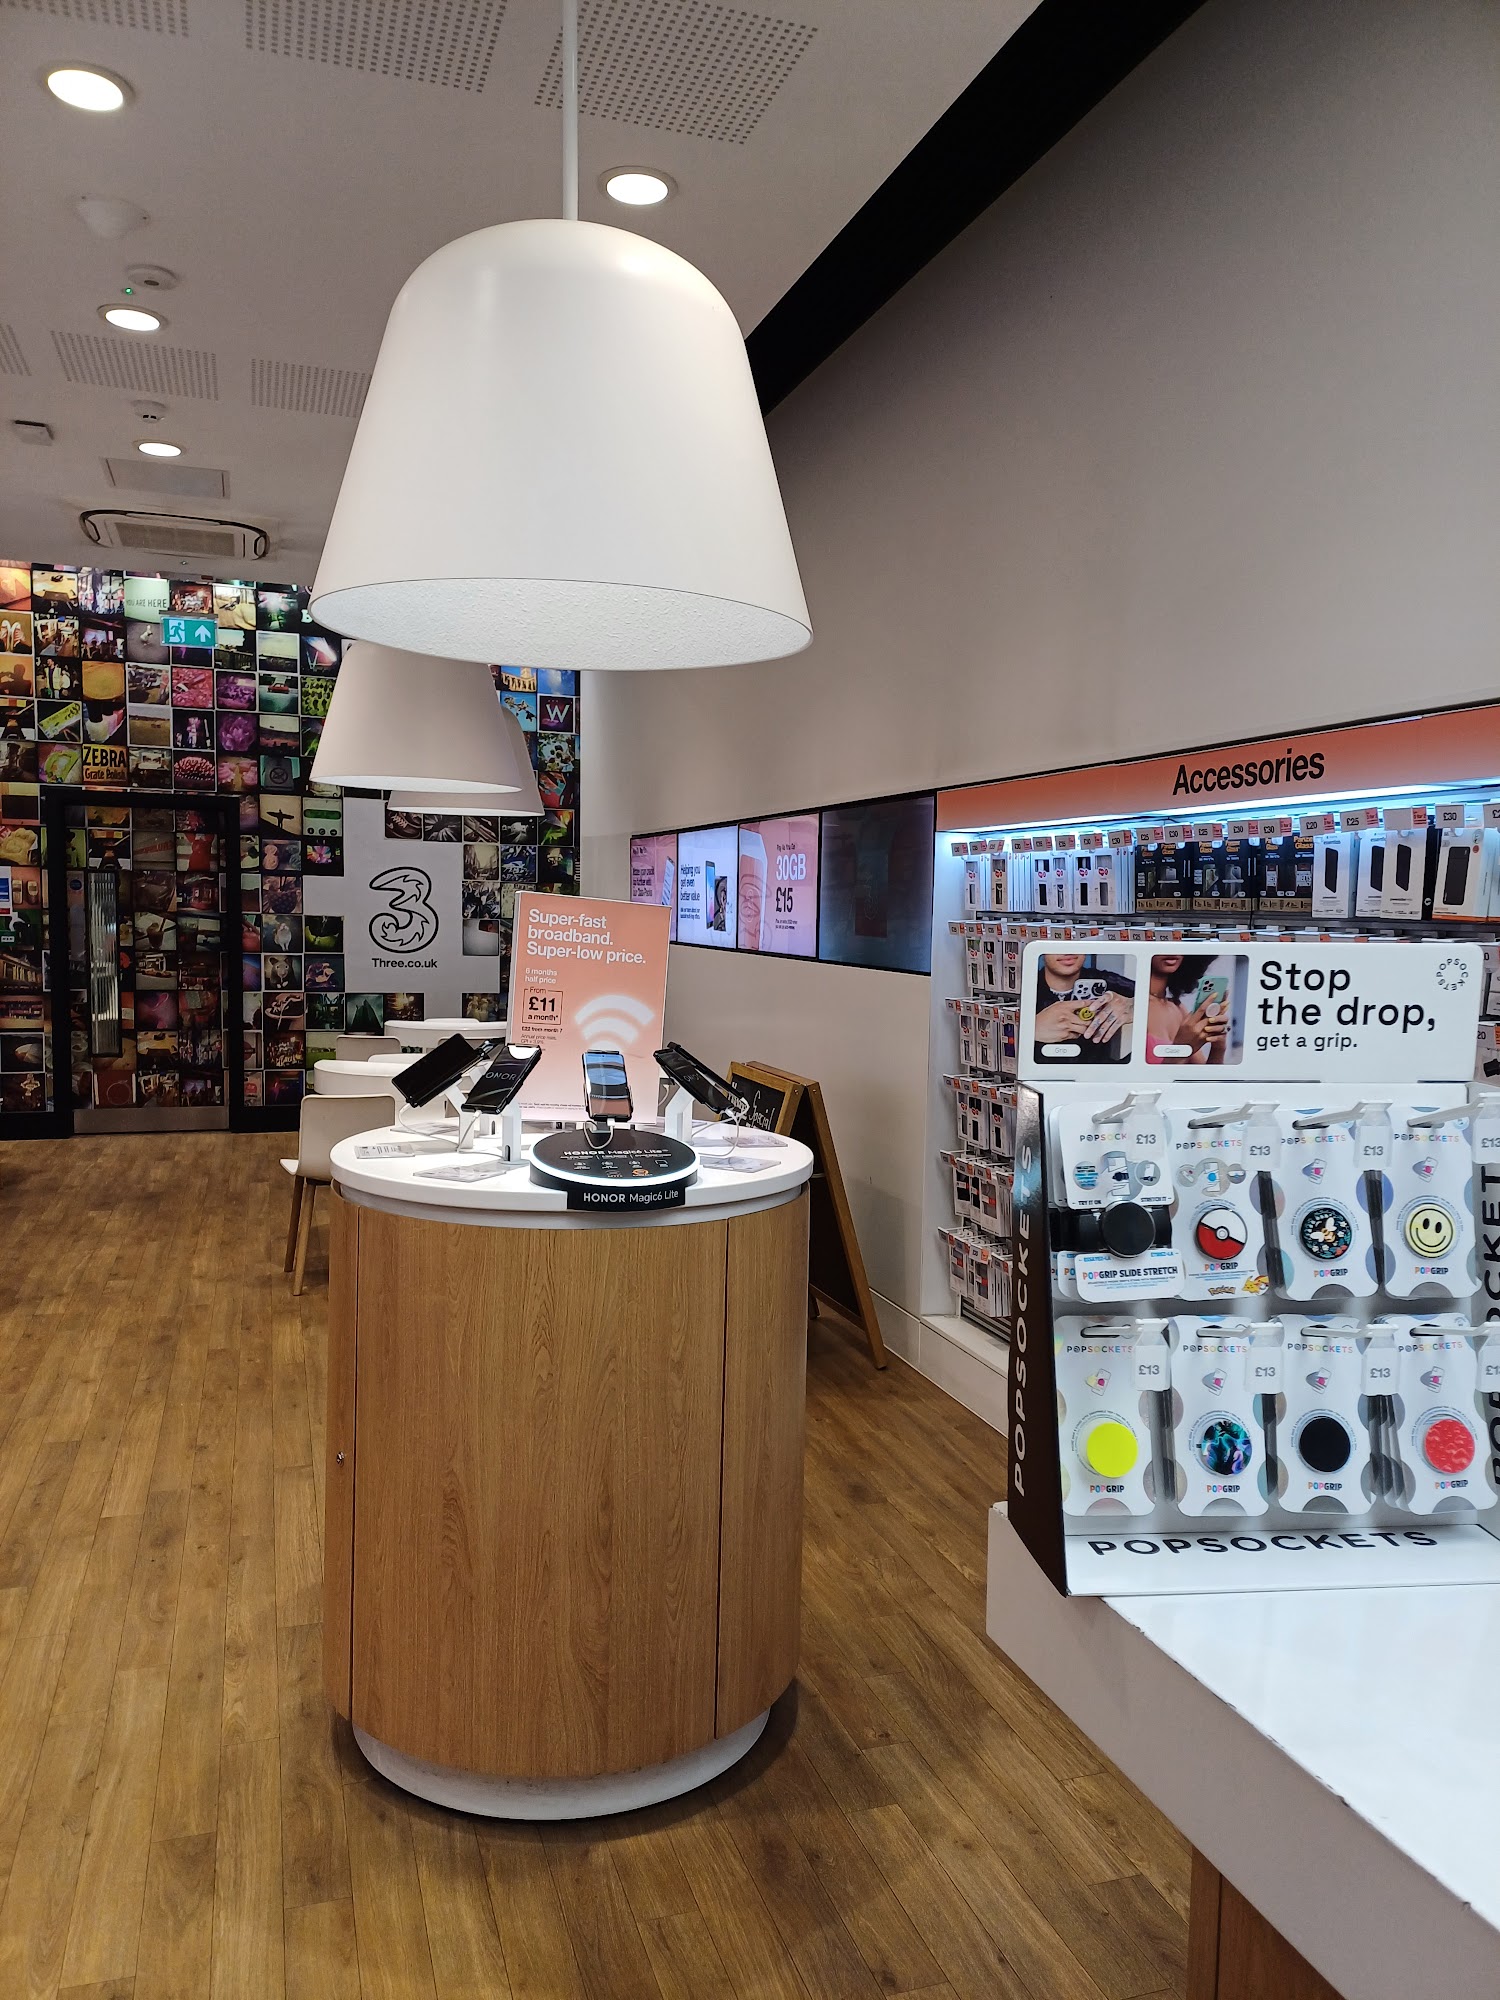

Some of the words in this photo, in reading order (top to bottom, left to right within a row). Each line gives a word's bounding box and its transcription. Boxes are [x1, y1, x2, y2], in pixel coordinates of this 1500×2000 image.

[135, 599, 146, 608] ARE
[147, 598, 167, 608] HERE
[545, 703, 570, 723] W
[83, 745, 126, 768] ZEBRA
[85, 768, 105, 780] Grate
[1172, 747, 1325, 796] Accessories
[1346, 817, 1360, 827] £25
[1443, 812, 1457, 821] £30
[775, 853, 807, 881] 30GB
[775, 887, 794, 913] £15
[528, 908, 607, 930] Super-fast
[527, 925, 614, 946] broadband.
[526, 941, 604, 960] Super-low
[606, 948, 647, 965] price.
[371, 957, 438, 969] Three.co.uk
[531, 969, 558, 977] months
[1436, 958, 1469, 991] POPSOCKETS
[525, 975, 539, 983] half
[538, 976, 557, 985] price
[1259, 960, 1351, 999] Stop
[529, 986, 547, 994] From
[528, 996, 556, 1013] £11
[1257, 997, 1323, 1027] the
[1336, 997, 1436, 1034] drop,
[1256, 1032, 1289, 1052] get
[1296, 1034, 1308, 1049] a
[1314, 1031, 1359, 1053] grip.
[485, 1071, 517, 1081] ONOR
[1135, 1134, 1157, 1146] £13
[1394, 1133, 1460, 1143] POPSOCKETS
[1175, 1139, 1242, 1150] POPSOCKETS
[1249, 1145, 1271, 1156] £13
[1363, 1145, 1384, 1156] £13
[583, 1192, 626, 1204] HONOR
[629, 1193, 662, 1205] Magic6
[664, 1190, 679, 1200] Lite
[1204, 1262, 1239, 1272] POPGRIP
[1313, 1268, 1349, 1278] POPGRIP
[1414, 1266, 1449, 1275] POPGRIP
[1082, 1270, 1118, 1281] POPGRIP
[1119, 1269, 1142, 1278] SLIDE
[1143, 1266, 1178, 1276] STRETCH
[1014, 1144, 1034, 1498] POPSOCKETS
[1182, 1344, 1248, 1353] POPSOCKETS
[1287, 1342, 1353, 1354] POPSOCKETS
[1398, 1341, 1463, 1353] POPSOCKETS
[1138, 1363, 1160, 1376] £13
[1254, 1366, 1276, 1378] £13
[1370, 1367, 1391, 1379] £13
[1485, 1364, 1500, 1376] £1
[1089, 1484, 1125, 1494] POPGRIP
[1206, 1484, 1241, 1494] POPGRIP
[1307, 1481, 1343, 1491] POPGRIP
[1434, 1479, 1469, 1490] POPGRIP
[1087, 1531, 1438, 1557] POPSOCKETS
